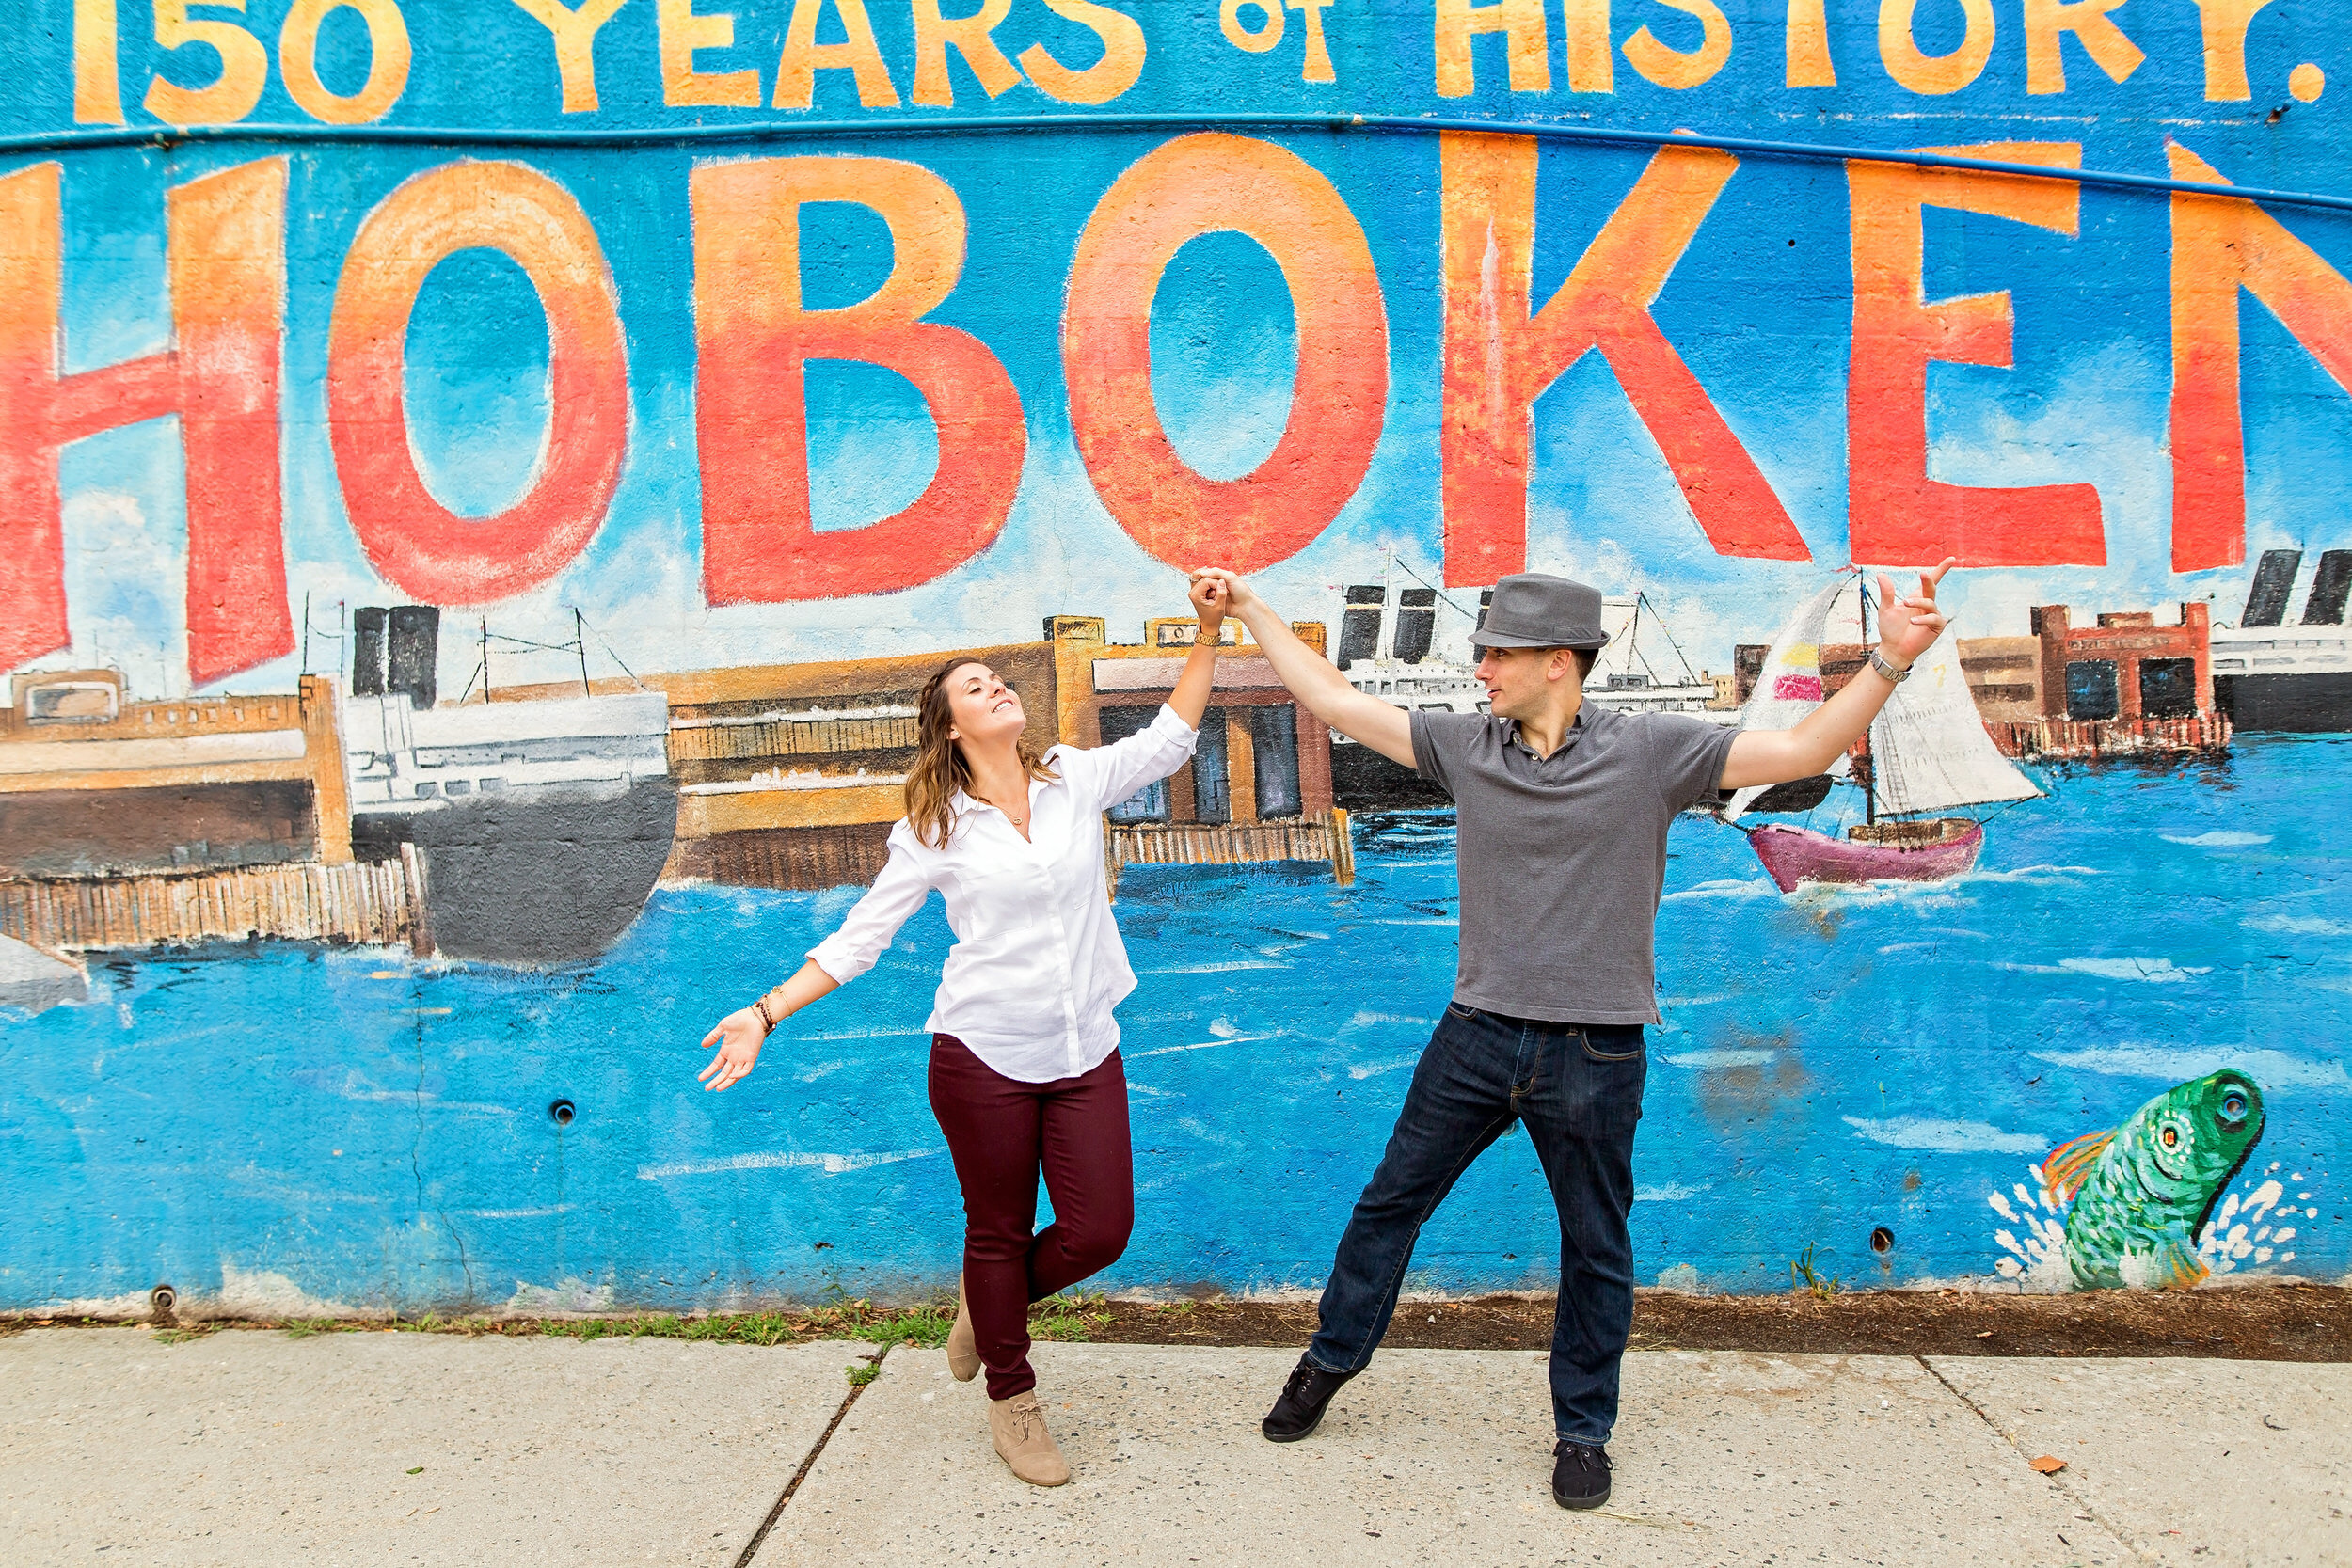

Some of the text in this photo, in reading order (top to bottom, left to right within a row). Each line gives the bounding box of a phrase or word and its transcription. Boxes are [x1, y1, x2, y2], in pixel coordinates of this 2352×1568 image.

[73, 0, 411, 124] 150
[511, 0, 1148, 113] YEARS
[0, 132, 2352, 687] HOBOKEN
